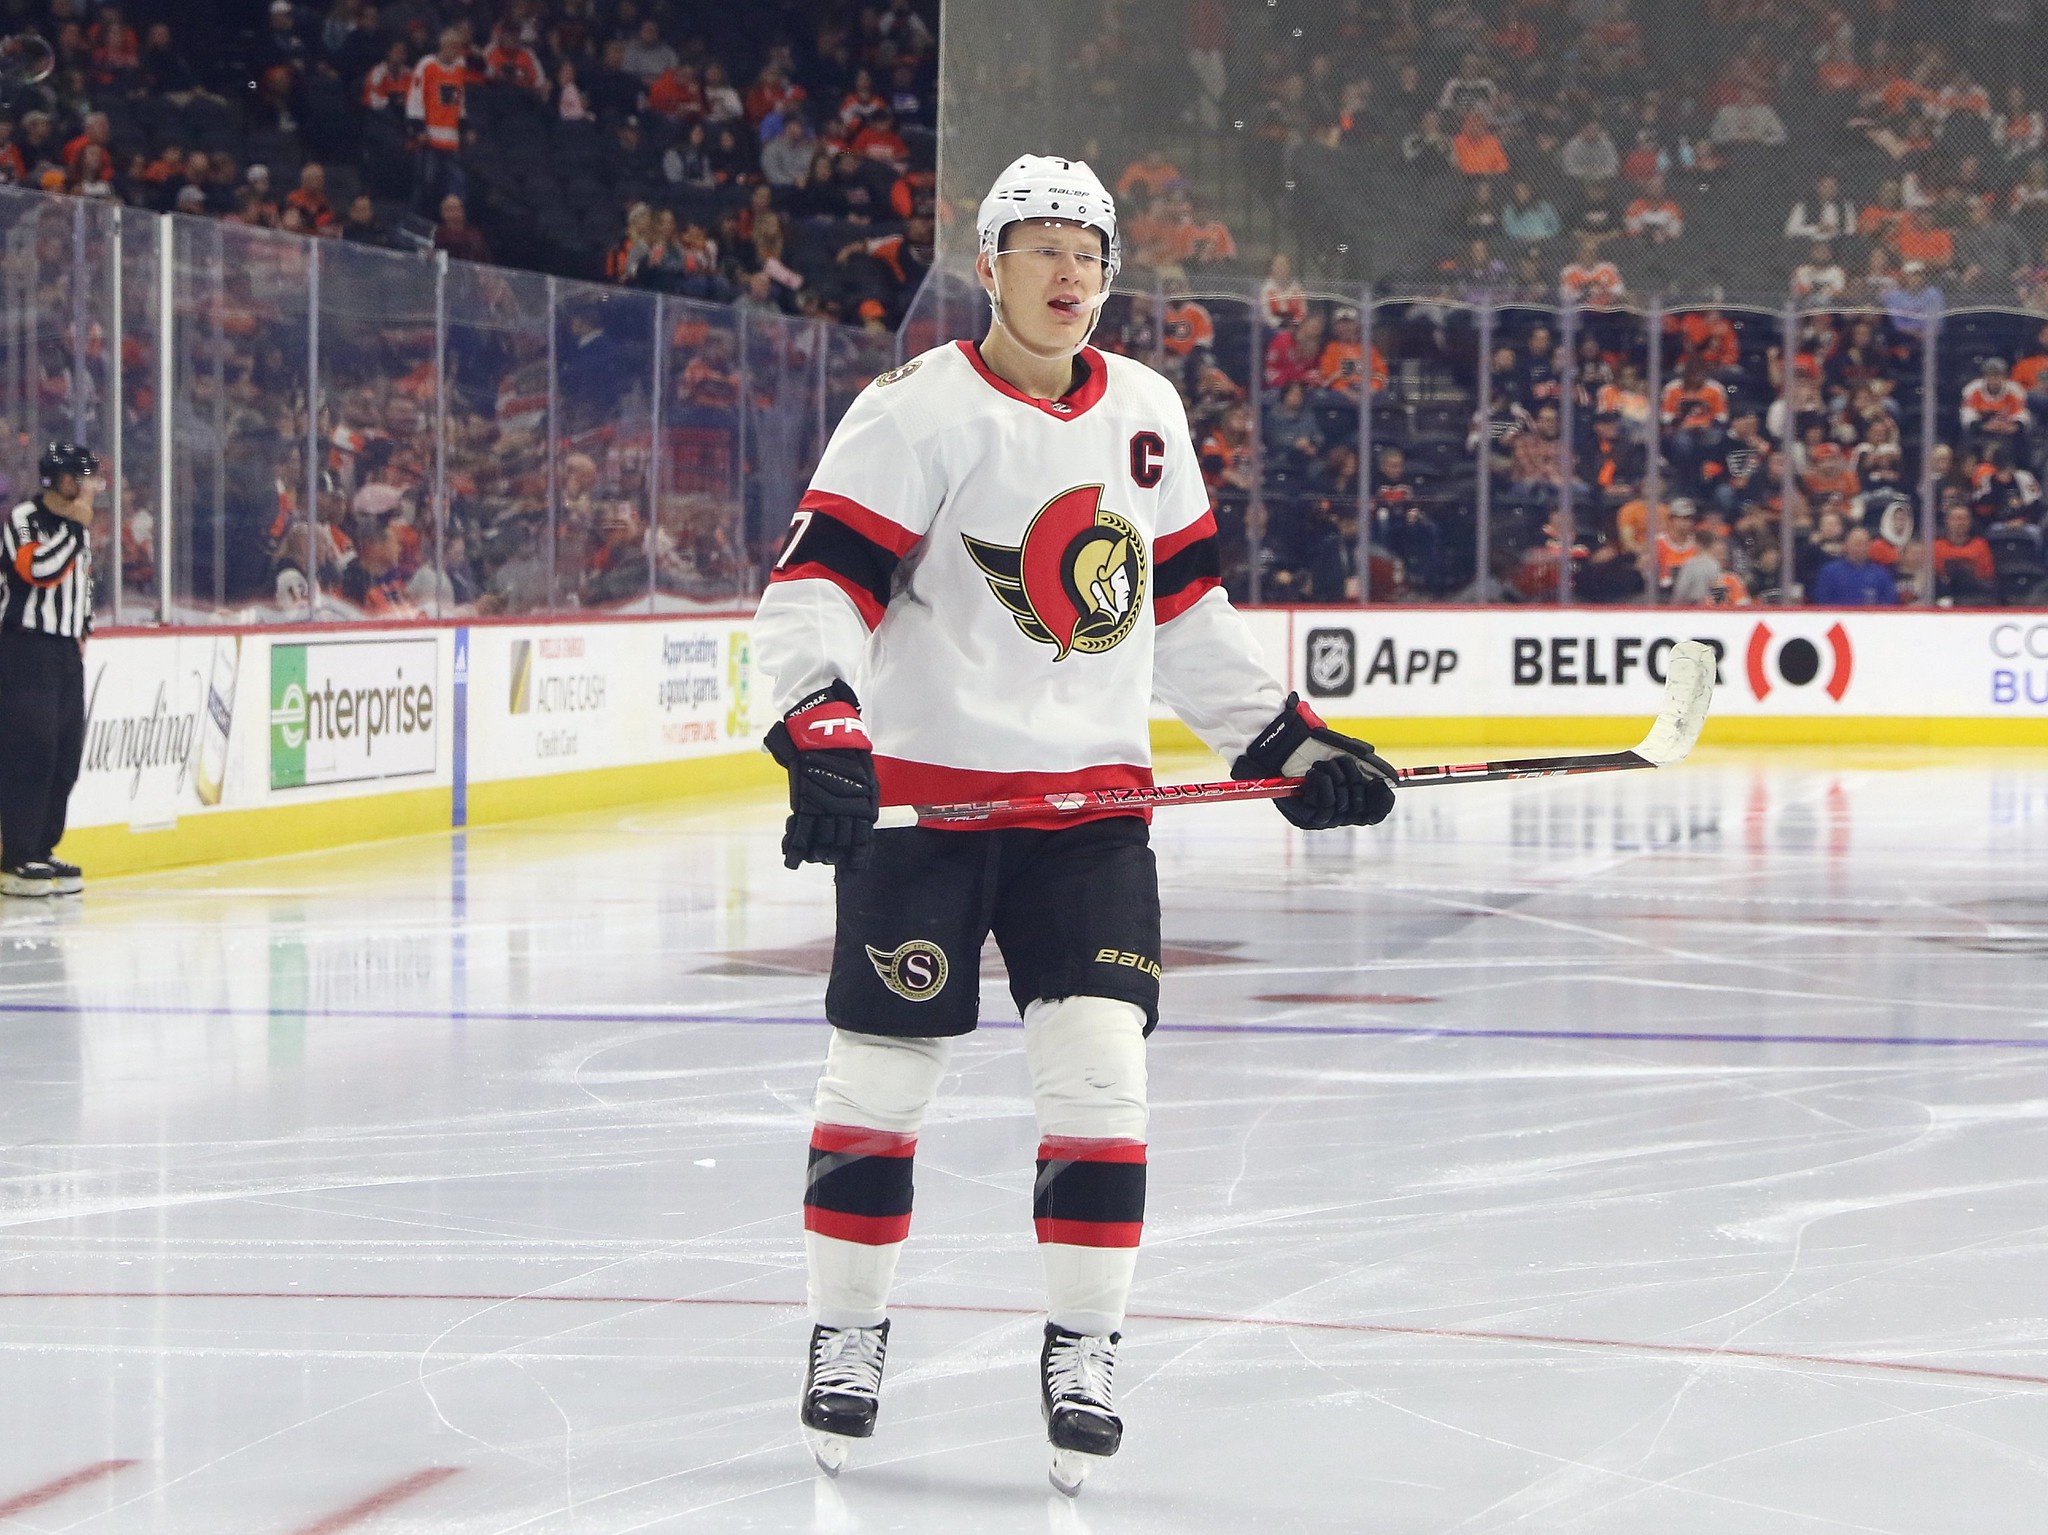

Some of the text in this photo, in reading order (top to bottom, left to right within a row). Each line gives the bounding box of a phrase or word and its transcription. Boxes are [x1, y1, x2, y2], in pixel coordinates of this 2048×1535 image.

[1129, 430, 1165, 489] C
[773, 508, 816, 571] 7
[537, 676, 577, 712] ACTIVE
[789, 693, 828, 718] TKACHUK
[271, 667, 434, 757] enterprise
[1259, 721, 1286, 748] TRUE
[931, 799, 1010, 814] TRUE
[944, 813, 989, 823] TRUE
[905, 954, 932, 989] S
